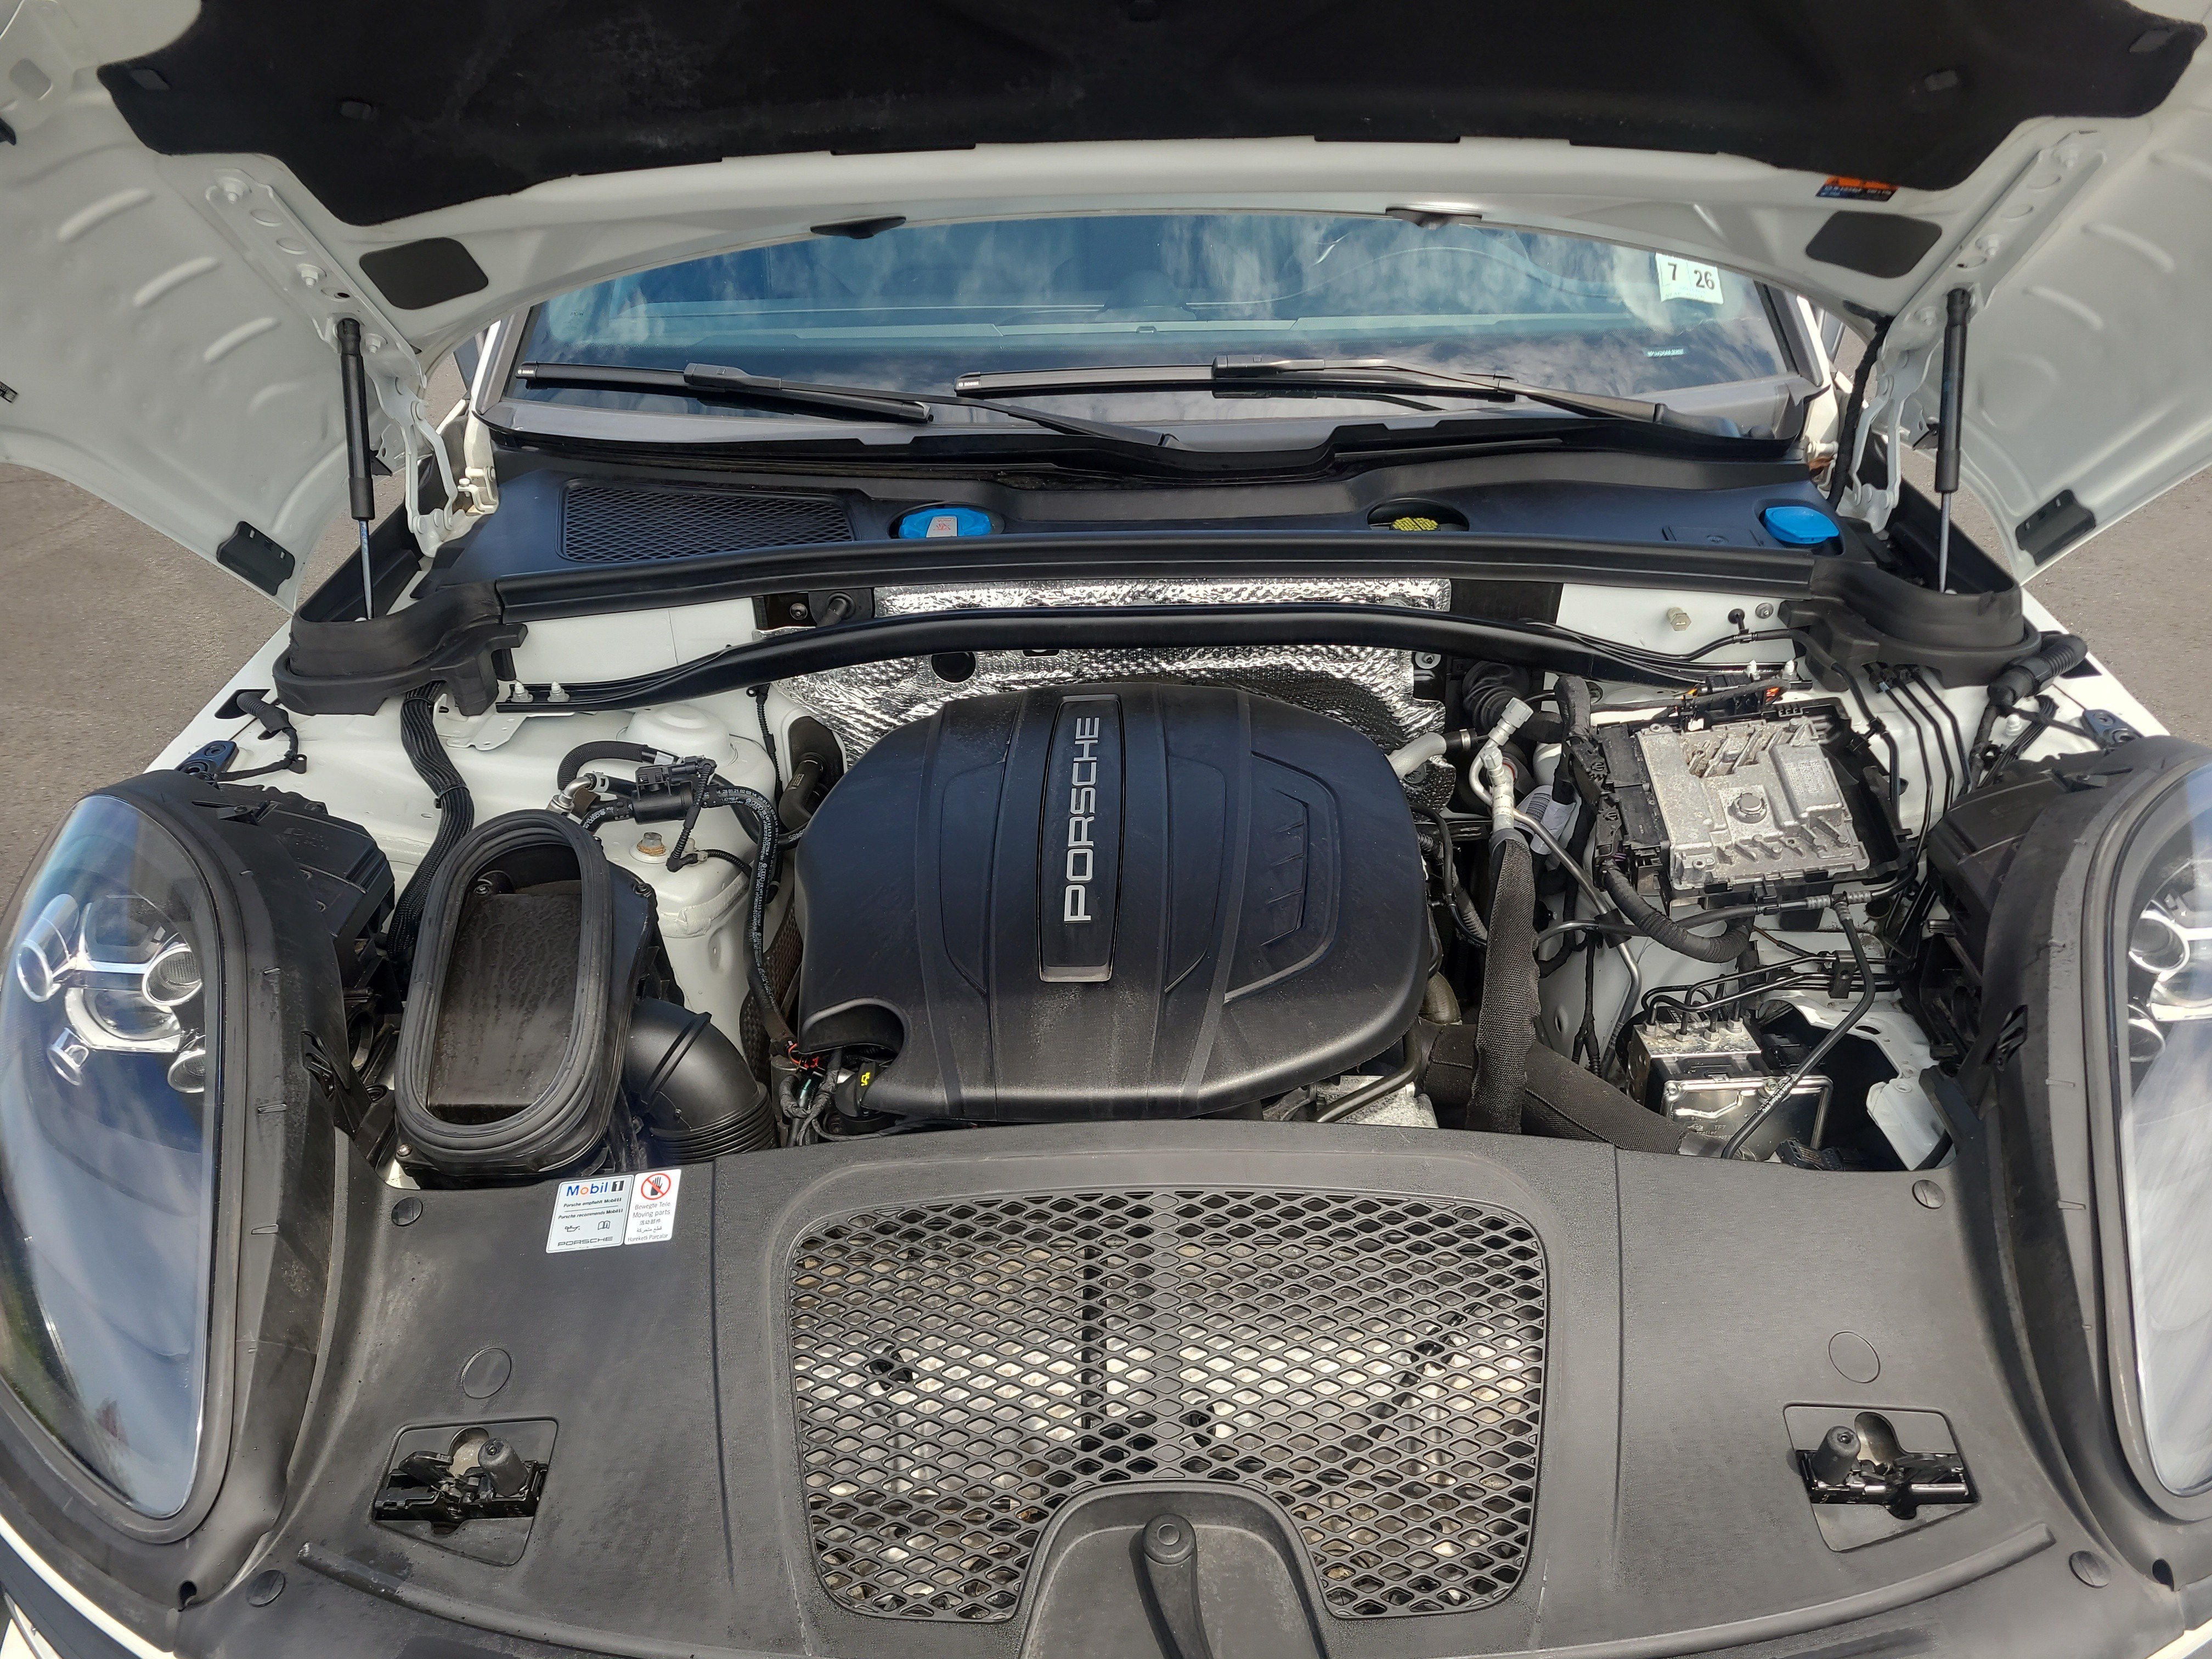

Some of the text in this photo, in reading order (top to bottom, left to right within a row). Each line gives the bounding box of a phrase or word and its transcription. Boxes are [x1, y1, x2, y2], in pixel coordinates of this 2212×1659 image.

[1668, 262, 1715, 290] 7 26
[1064, 716, 1100, 922] PORSCHE
[566, 1182, 608, 1196] Mobil
[557, 1236, 613, 1246] PORSCHE
